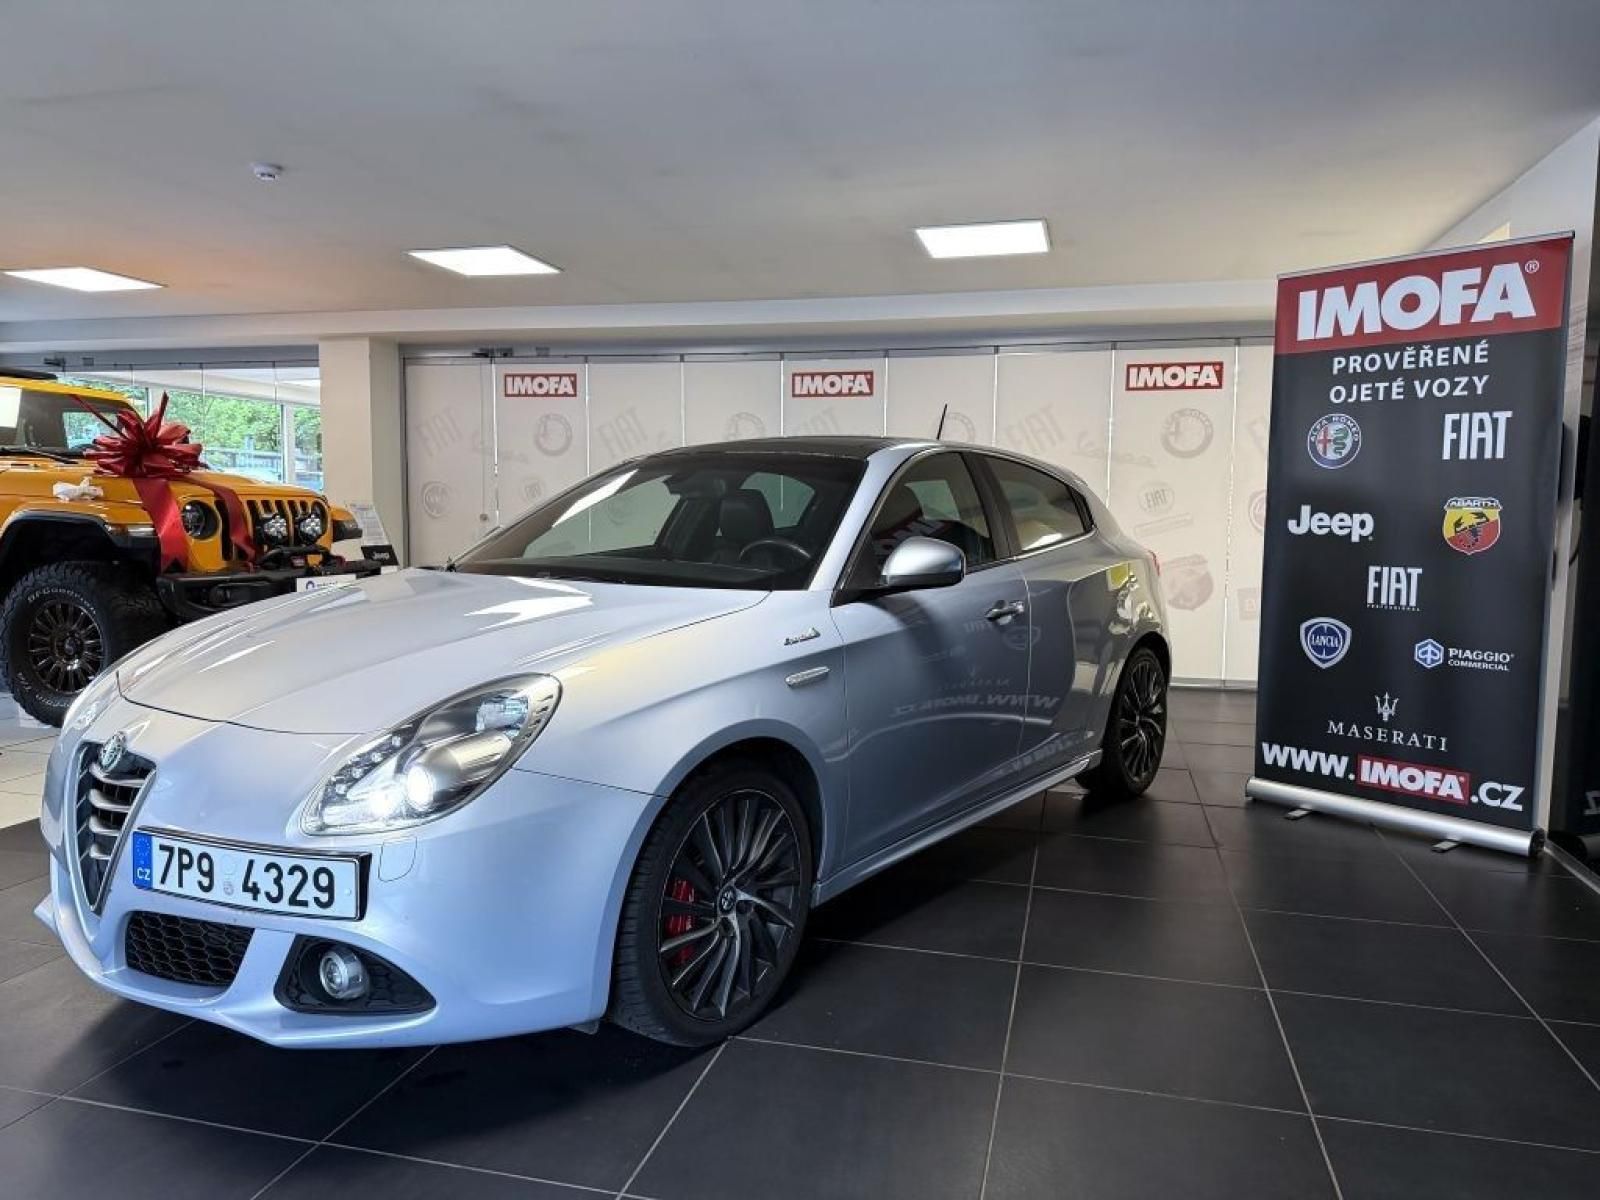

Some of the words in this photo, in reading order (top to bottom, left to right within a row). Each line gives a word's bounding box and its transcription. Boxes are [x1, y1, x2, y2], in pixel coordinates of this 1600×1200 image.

[1332, 339, 1490, 376] PROVĚŘENÉ
[505, 375, 575, 395] IMOFA
[794, 373, 872, 395] IMOFA
[1128, 364, 1220, 389] IMOFA
[1329, 378, 1405, 405] OJETÉ
[1414, 374, 1491, 400] VOZY
[1442, 411, 1513, 460] FIAT
[1287, 505, 1375, 543] Jeep
[1367, 565, 1423, 607] FIAT
[1311, 634, 1339, 648] LANCIA
[1447, 648, 1510, 664] PIAGGIO
[1447, 659, 1510, 672] COMMERCIAL
[1327, 720, 1449, 752] MASERATI
[136, 868, 151, 881] CZ
[158, 845, 215, 893] 7P9
[241, 859, 335, 910] 4329
